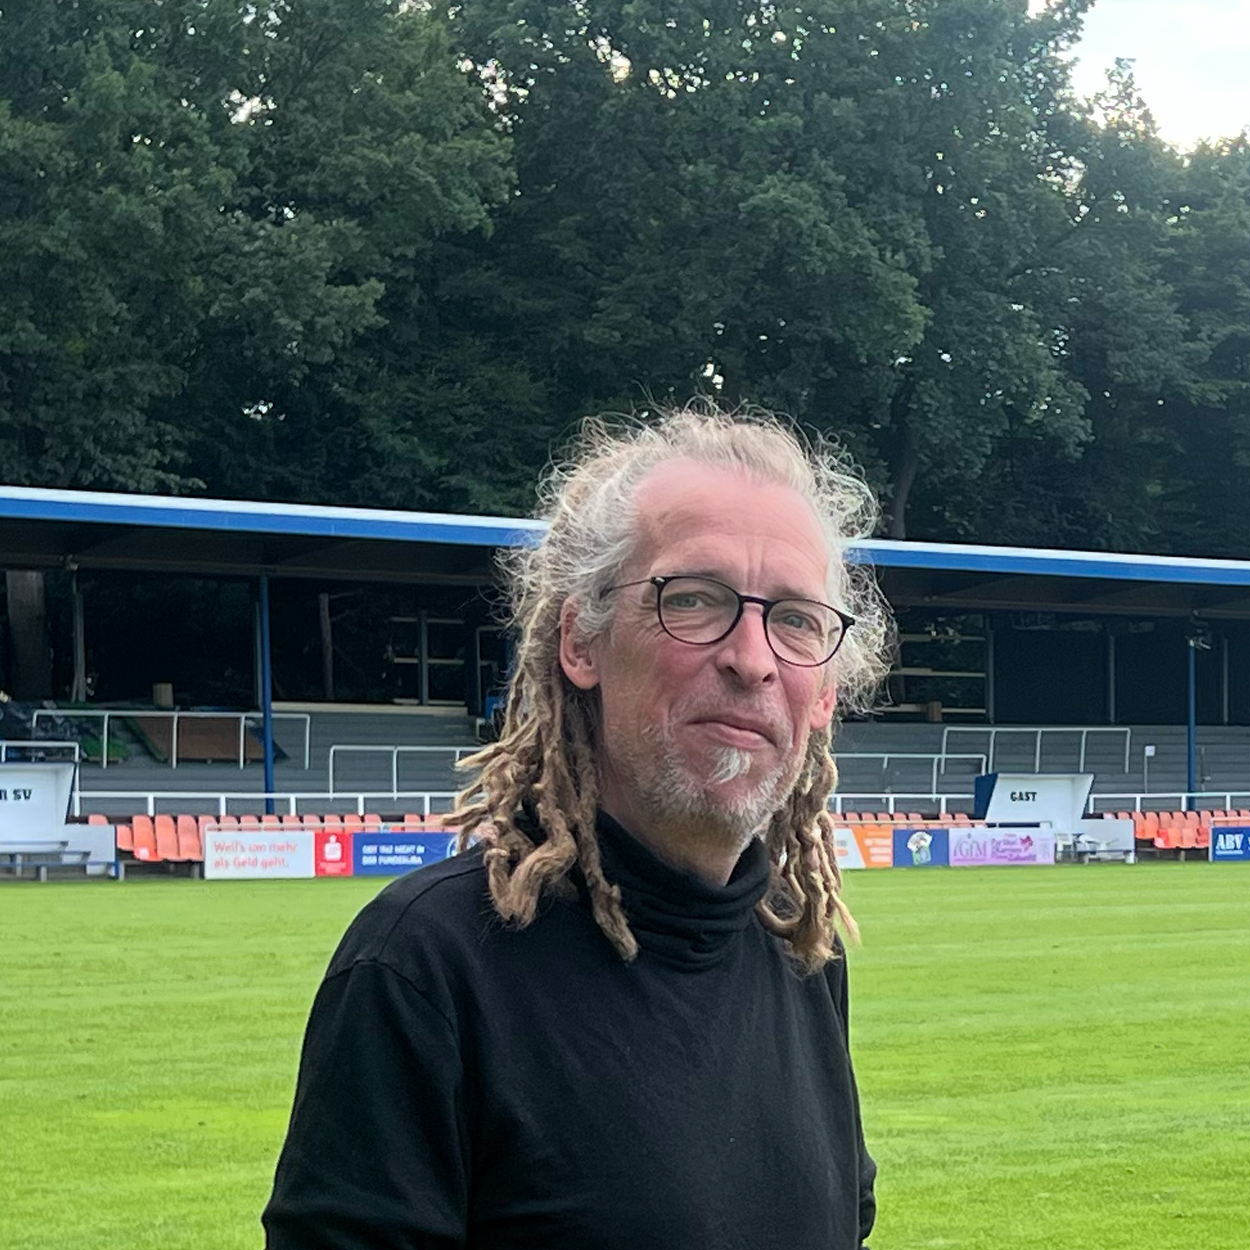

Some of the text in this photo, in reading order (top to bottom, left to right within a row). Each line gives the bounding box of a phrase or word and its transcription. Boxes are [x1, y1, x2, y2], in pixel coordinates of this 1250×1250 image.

[12, 788, 32, 801] SV
[1010, 791, 1037, 802] GAST
[269, 840, 298, 853] mehr
[1215, 833, 1245, 850] ABV
[213, 857, 229, 869] als
[233, 856, 258, 869] Geld
